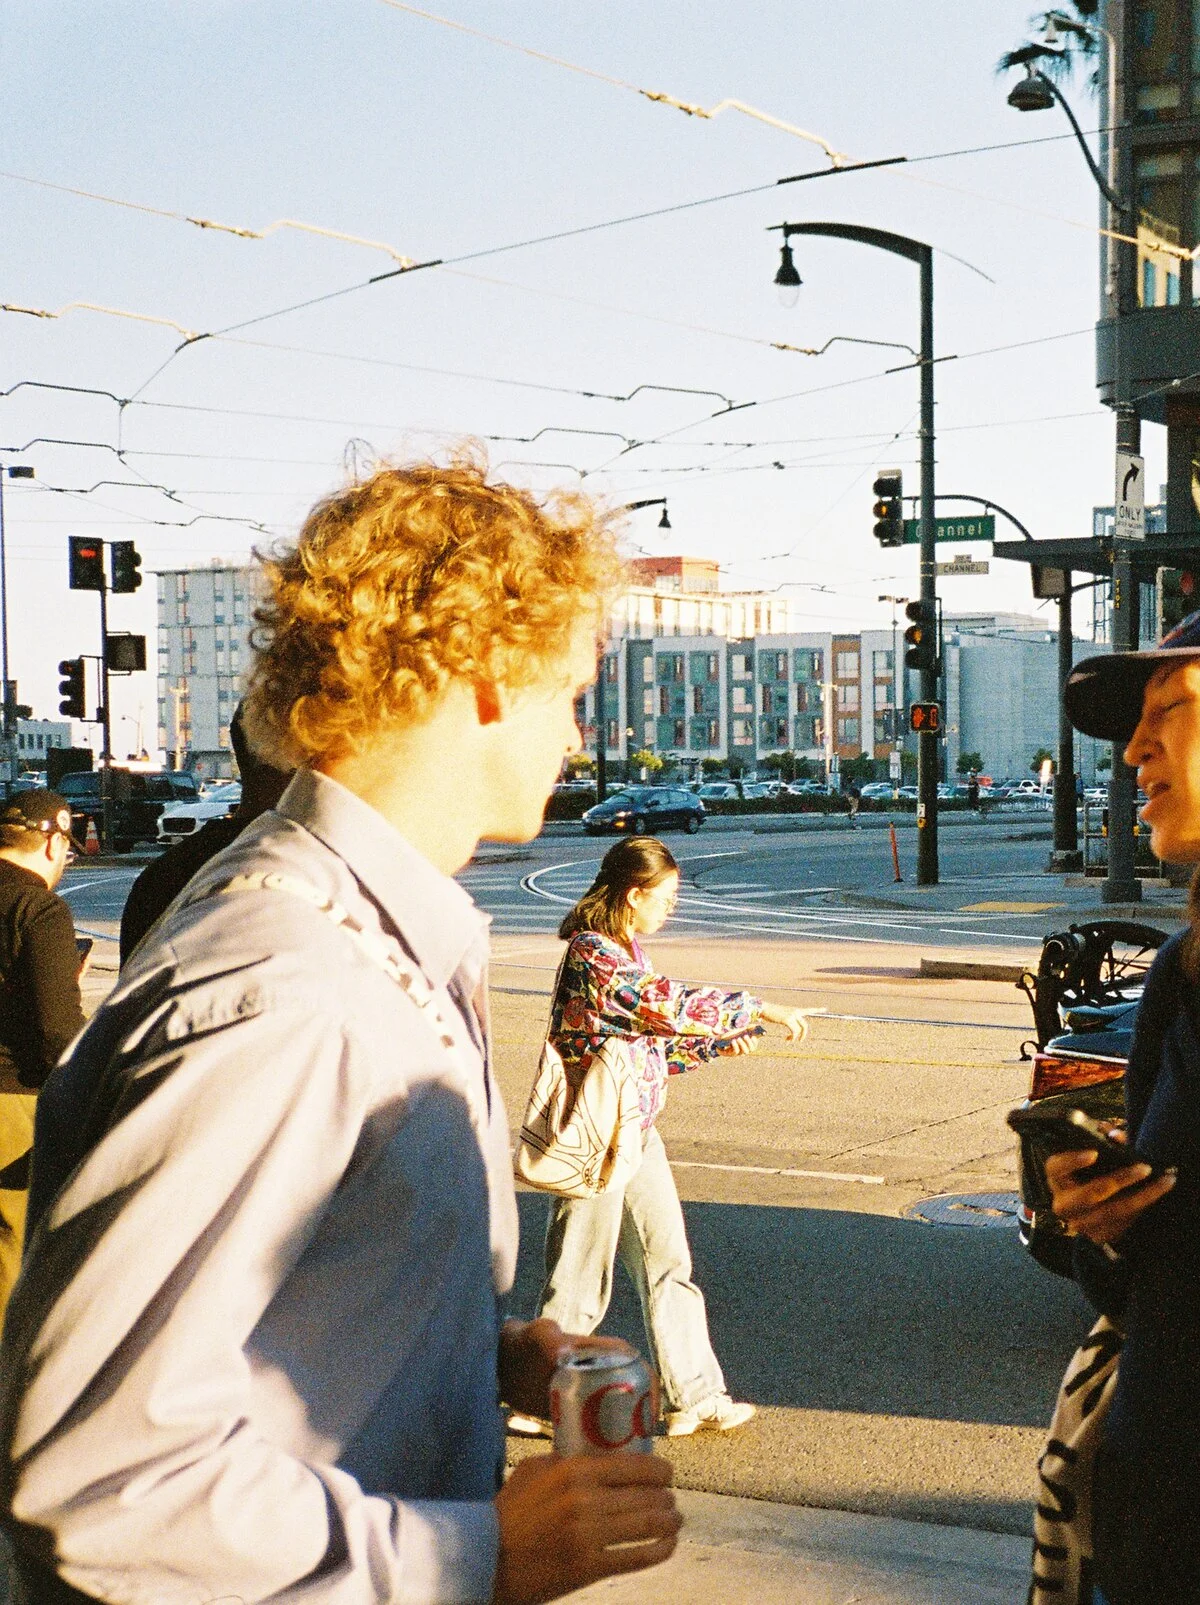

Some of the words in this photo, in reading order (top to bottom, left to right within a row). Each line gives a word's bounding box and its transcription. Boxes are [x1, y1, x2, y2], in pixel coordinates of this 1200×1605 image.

[1119, 504, 1141, 521] ONLY
[915, 522, 982, 538] Cannel
[943, 563, 981, 573] CHANNEL
